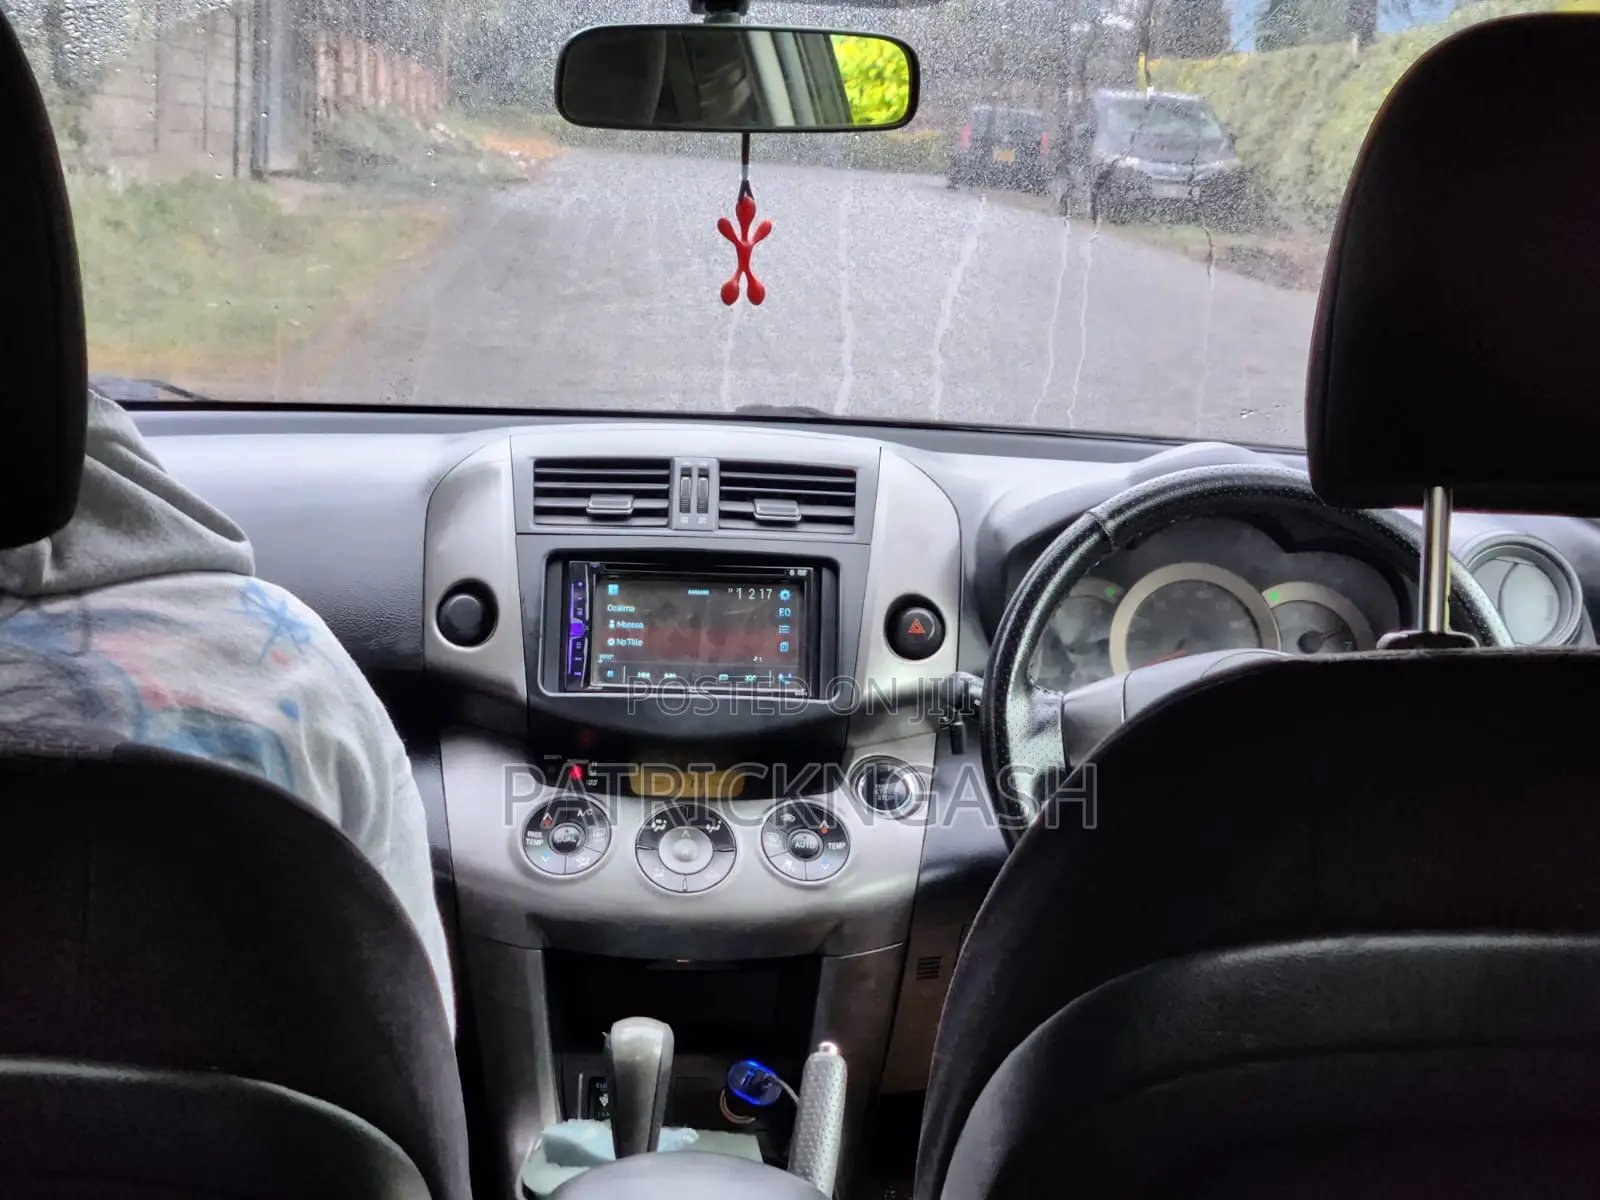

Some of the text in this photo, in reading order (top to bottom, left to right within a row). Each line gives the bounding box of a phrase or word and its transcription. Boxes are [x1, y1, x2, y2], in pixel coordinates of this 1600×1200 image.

[778, 607, 791, 618] EQ
[577, 808, 593, 818] A/C
[526, 838, 544, 846] TEMP
[794, 841, 818, 850] AUTO
[827, 841, 846, 850] TEMP
